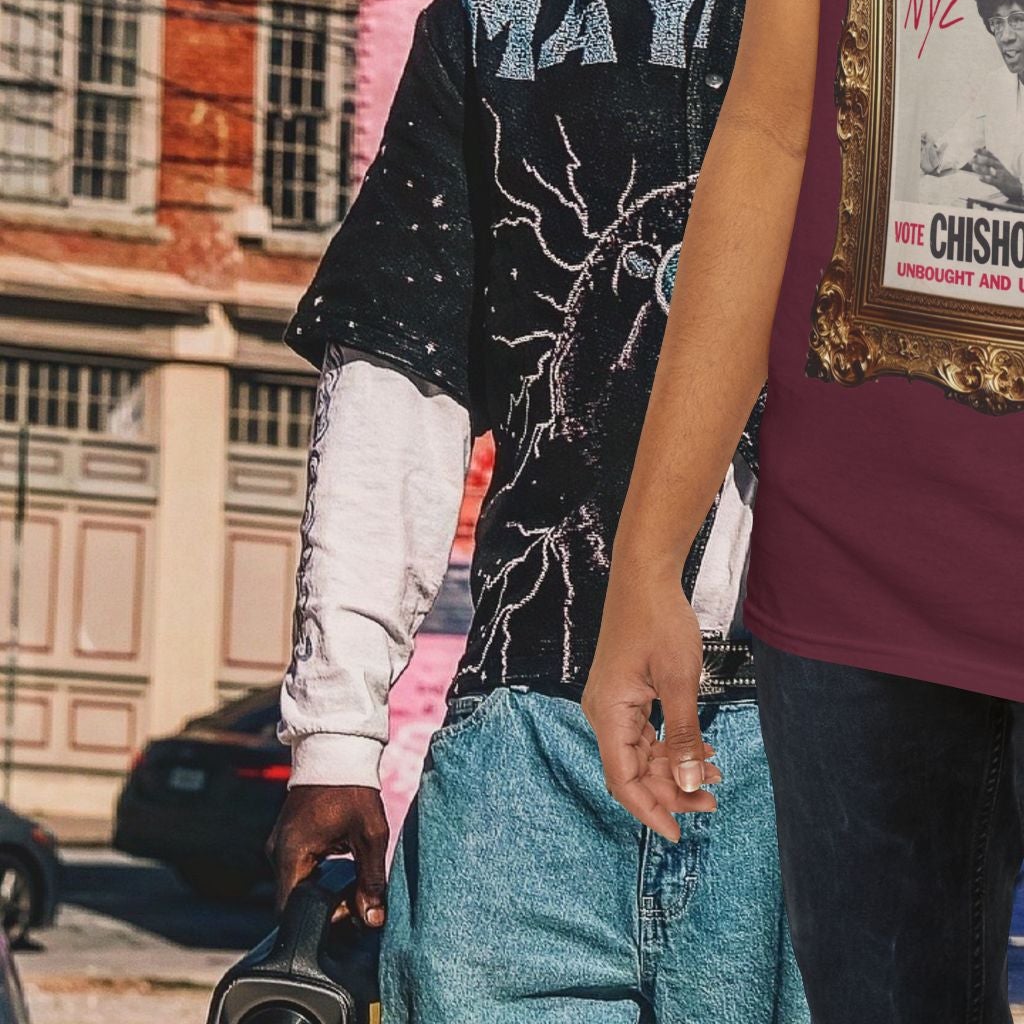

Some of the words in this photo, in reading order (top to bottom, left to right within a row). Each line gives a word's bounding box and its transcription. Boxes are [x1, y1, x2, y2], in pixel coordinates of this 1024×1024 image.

[895, 221, 925, 246] VOTE
[897, 262, 974, 286] UNBOUGHT
[979, 273, 1011, 291] AND
